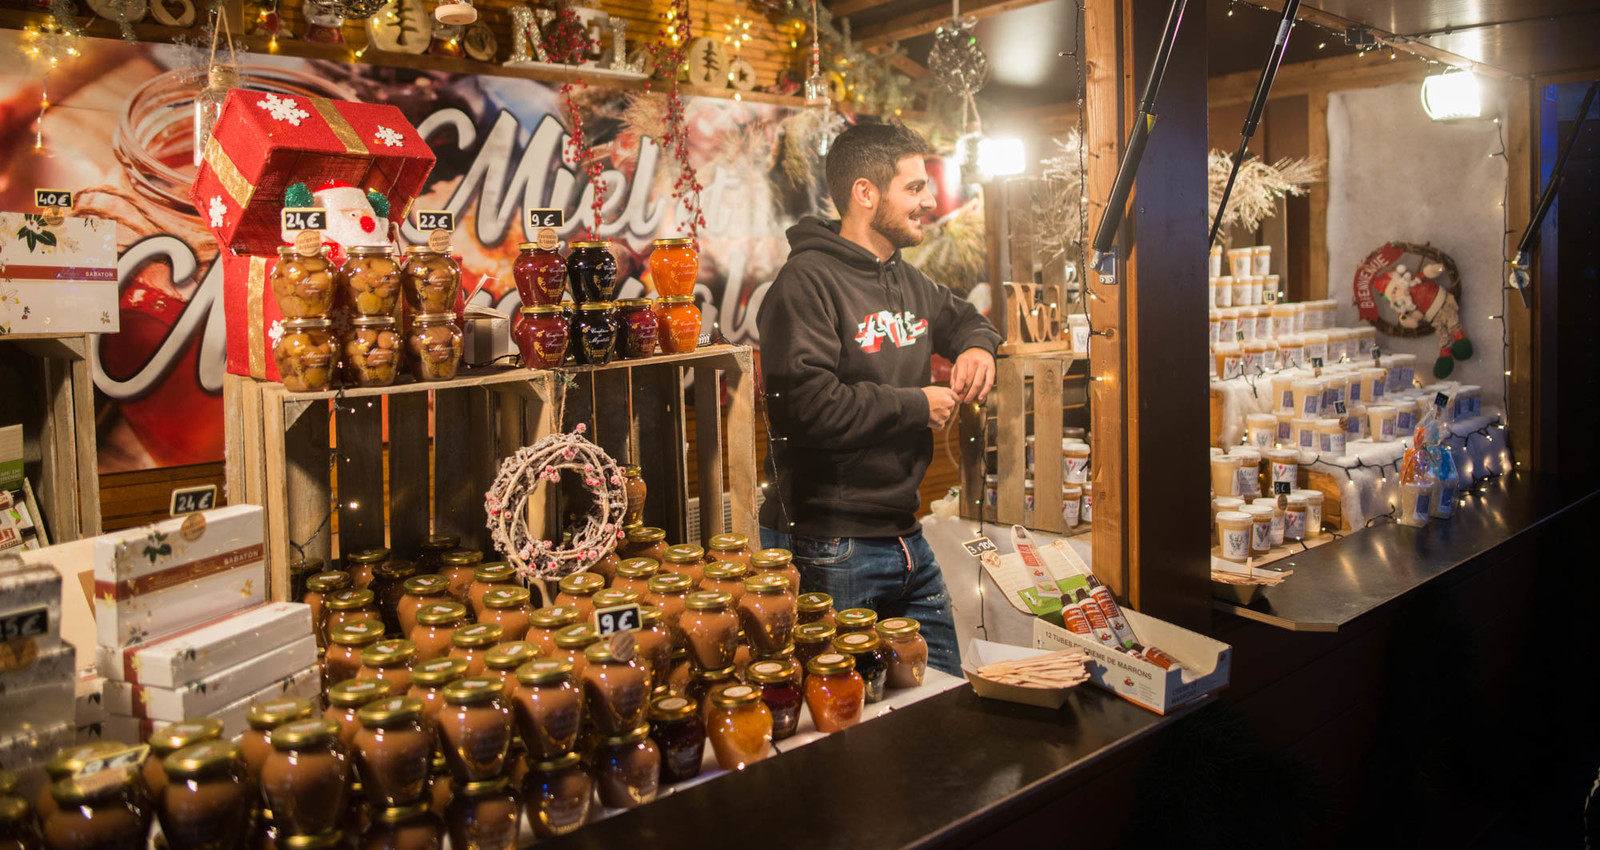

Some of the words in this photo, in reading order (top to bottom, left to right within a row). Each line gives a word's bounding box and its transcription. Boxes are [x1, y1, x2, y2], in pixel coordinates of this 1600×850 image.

[400, 108, 665, 246] Miel
[38, 193, 69, 207] 40€
[286, 212, 320, 230] 24€
[419, 214, 448, 229] 22€
[223, 550, 259, 566] SABATON
[1045, 631, 1053, 639] 12
[1052, 634, 1073, 648] TUBES
[1107, 656, 1116, 666] DE
[1117, 660, 1153, 680] MARRONS
